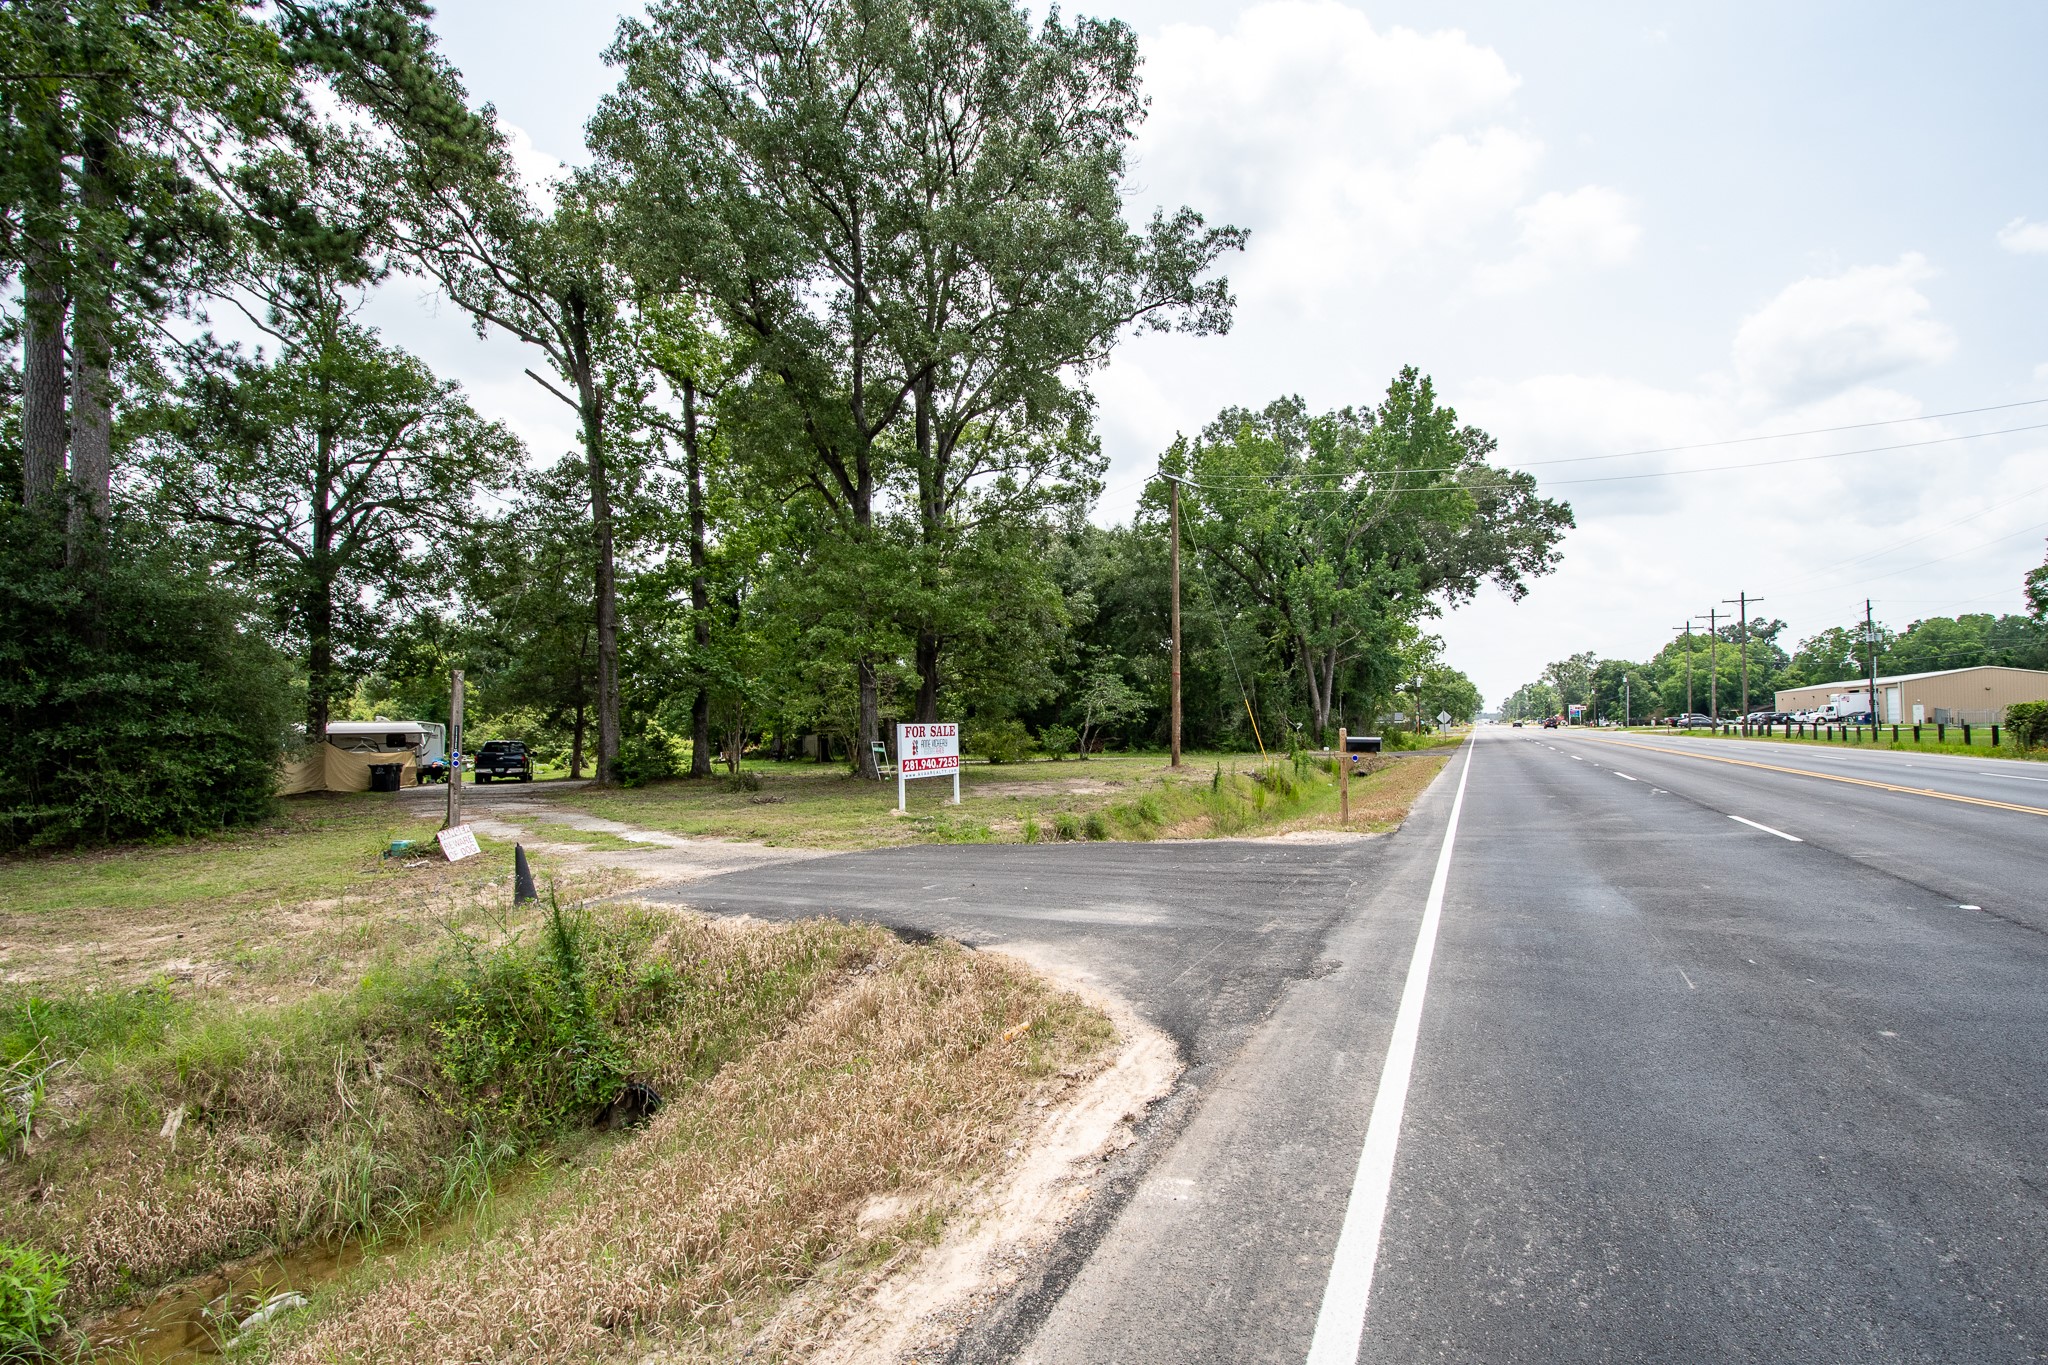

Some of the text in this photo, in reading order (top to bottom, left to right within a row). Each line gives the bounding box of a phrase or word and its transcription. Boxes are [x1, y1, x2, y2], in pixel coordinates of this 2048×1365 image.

[905, 726, 955, 738] FOR SALE
[904, 757, 957, 771] 281.940.7253
[440, 824, 470, 840] DANGER
[444, 835, 475, 851] BEWARE
[449, 844, 477, 859] OF DOG
